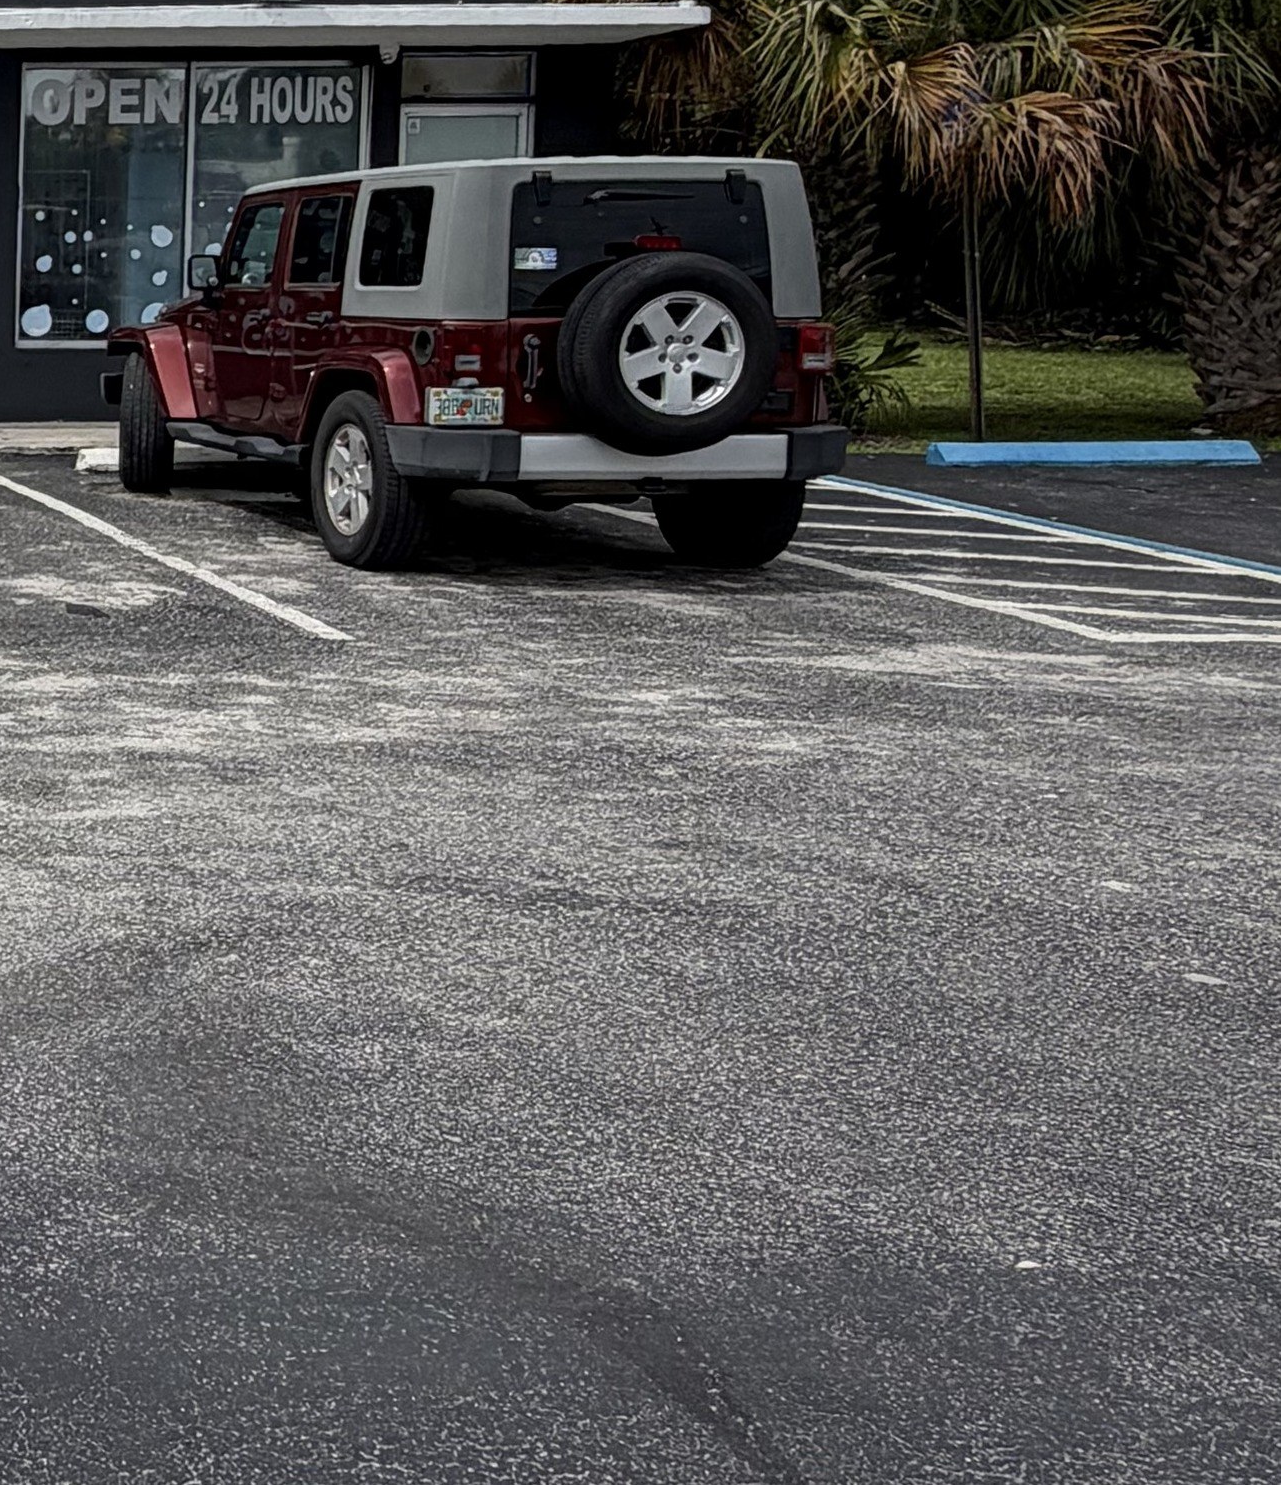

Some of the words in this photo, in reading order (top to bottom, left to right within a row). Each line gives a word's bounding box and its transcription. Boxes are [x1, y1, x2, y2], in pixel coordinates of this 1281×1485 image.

[31, 78, 182, 126] OPEN
[201, 77, 238, 124] 24
[249, 76, 354, 124] HOURS
